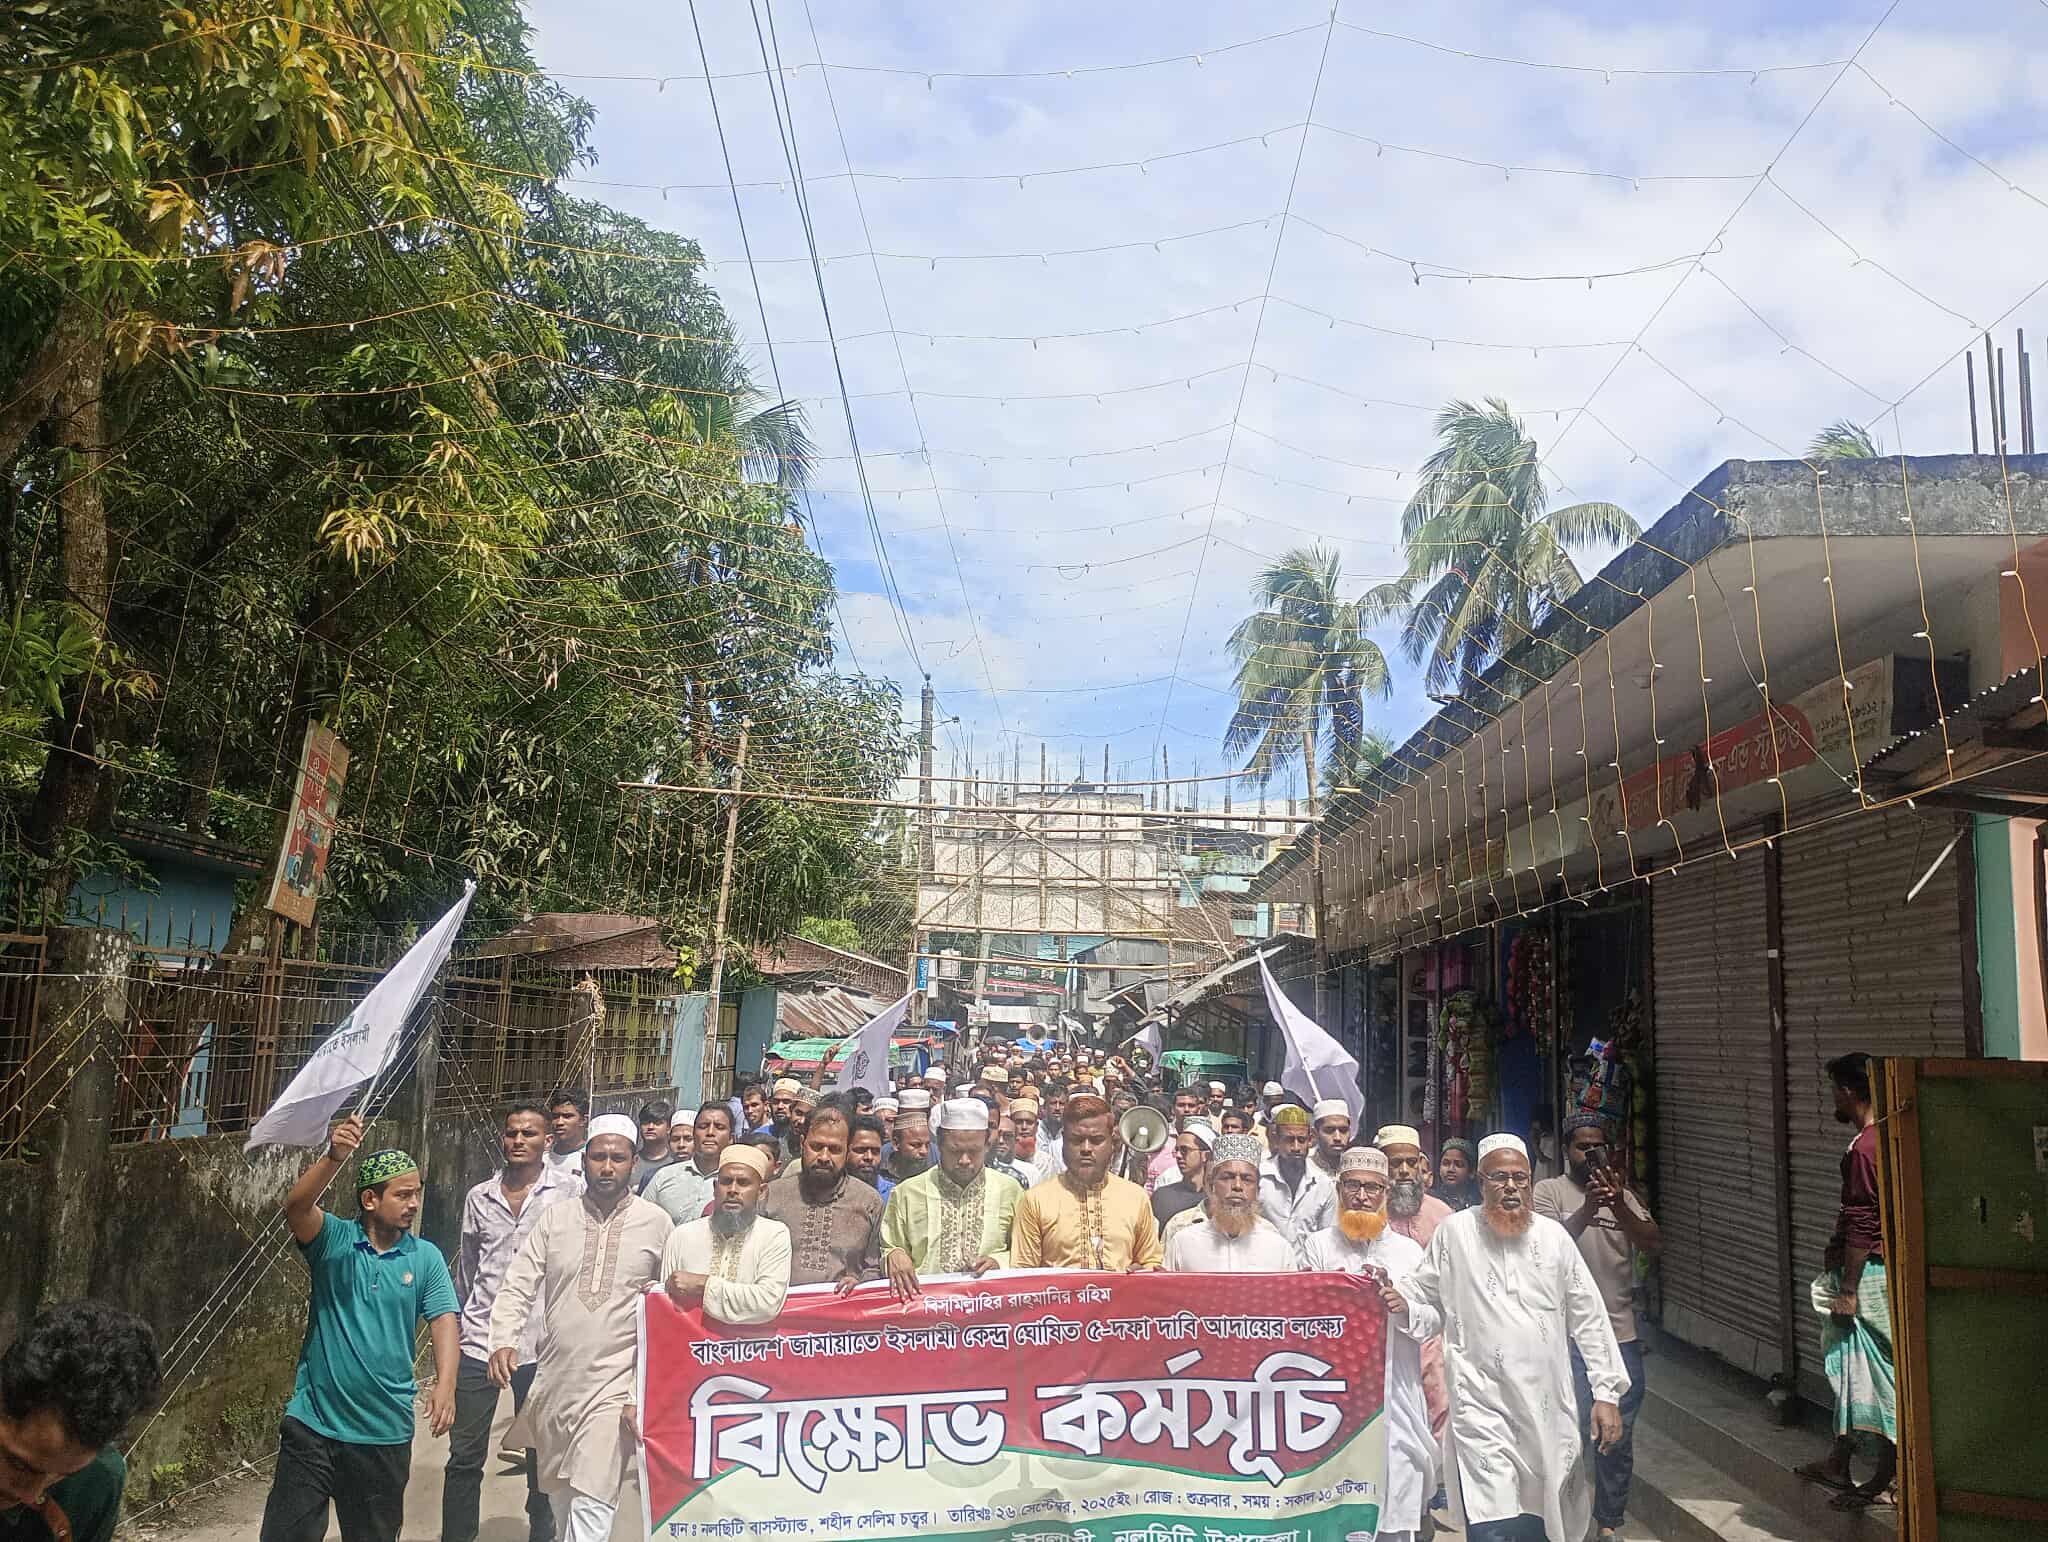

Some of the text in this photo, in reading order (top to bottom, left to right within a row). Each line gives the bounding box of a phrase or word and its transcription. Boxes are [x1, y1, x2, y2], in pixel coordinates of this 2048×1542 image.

[1076, 1283, 1112, 1304] রহিম
[690, 1310, 1346, 1366] বাংলাদেশ জামায়াতে ইসলামী কেন্দ্র ঘোষিত ৫-দফা দাবি আদায়ের লক্ষ্যে
[689, 1348, 1348, 1494] বিক্ষোভ কর্মসূচি
[668, 1522, 689, 1539] স্থান
[700, 1518, 745, 1538] নলছিটি
[819, 1511, 854, 1531] শহীদ
[857, 1509, 896, 1529] সেলিম
[995, 1506, 1016, 1521] ২৬
[1143, 1490, 1174, 1505] রোজ
[1242, 1495, 1271, 1509] সময়
[1284, 1491, 1317, 1508] সকাল
[1318, 1489, 1333, 1502] ১০
